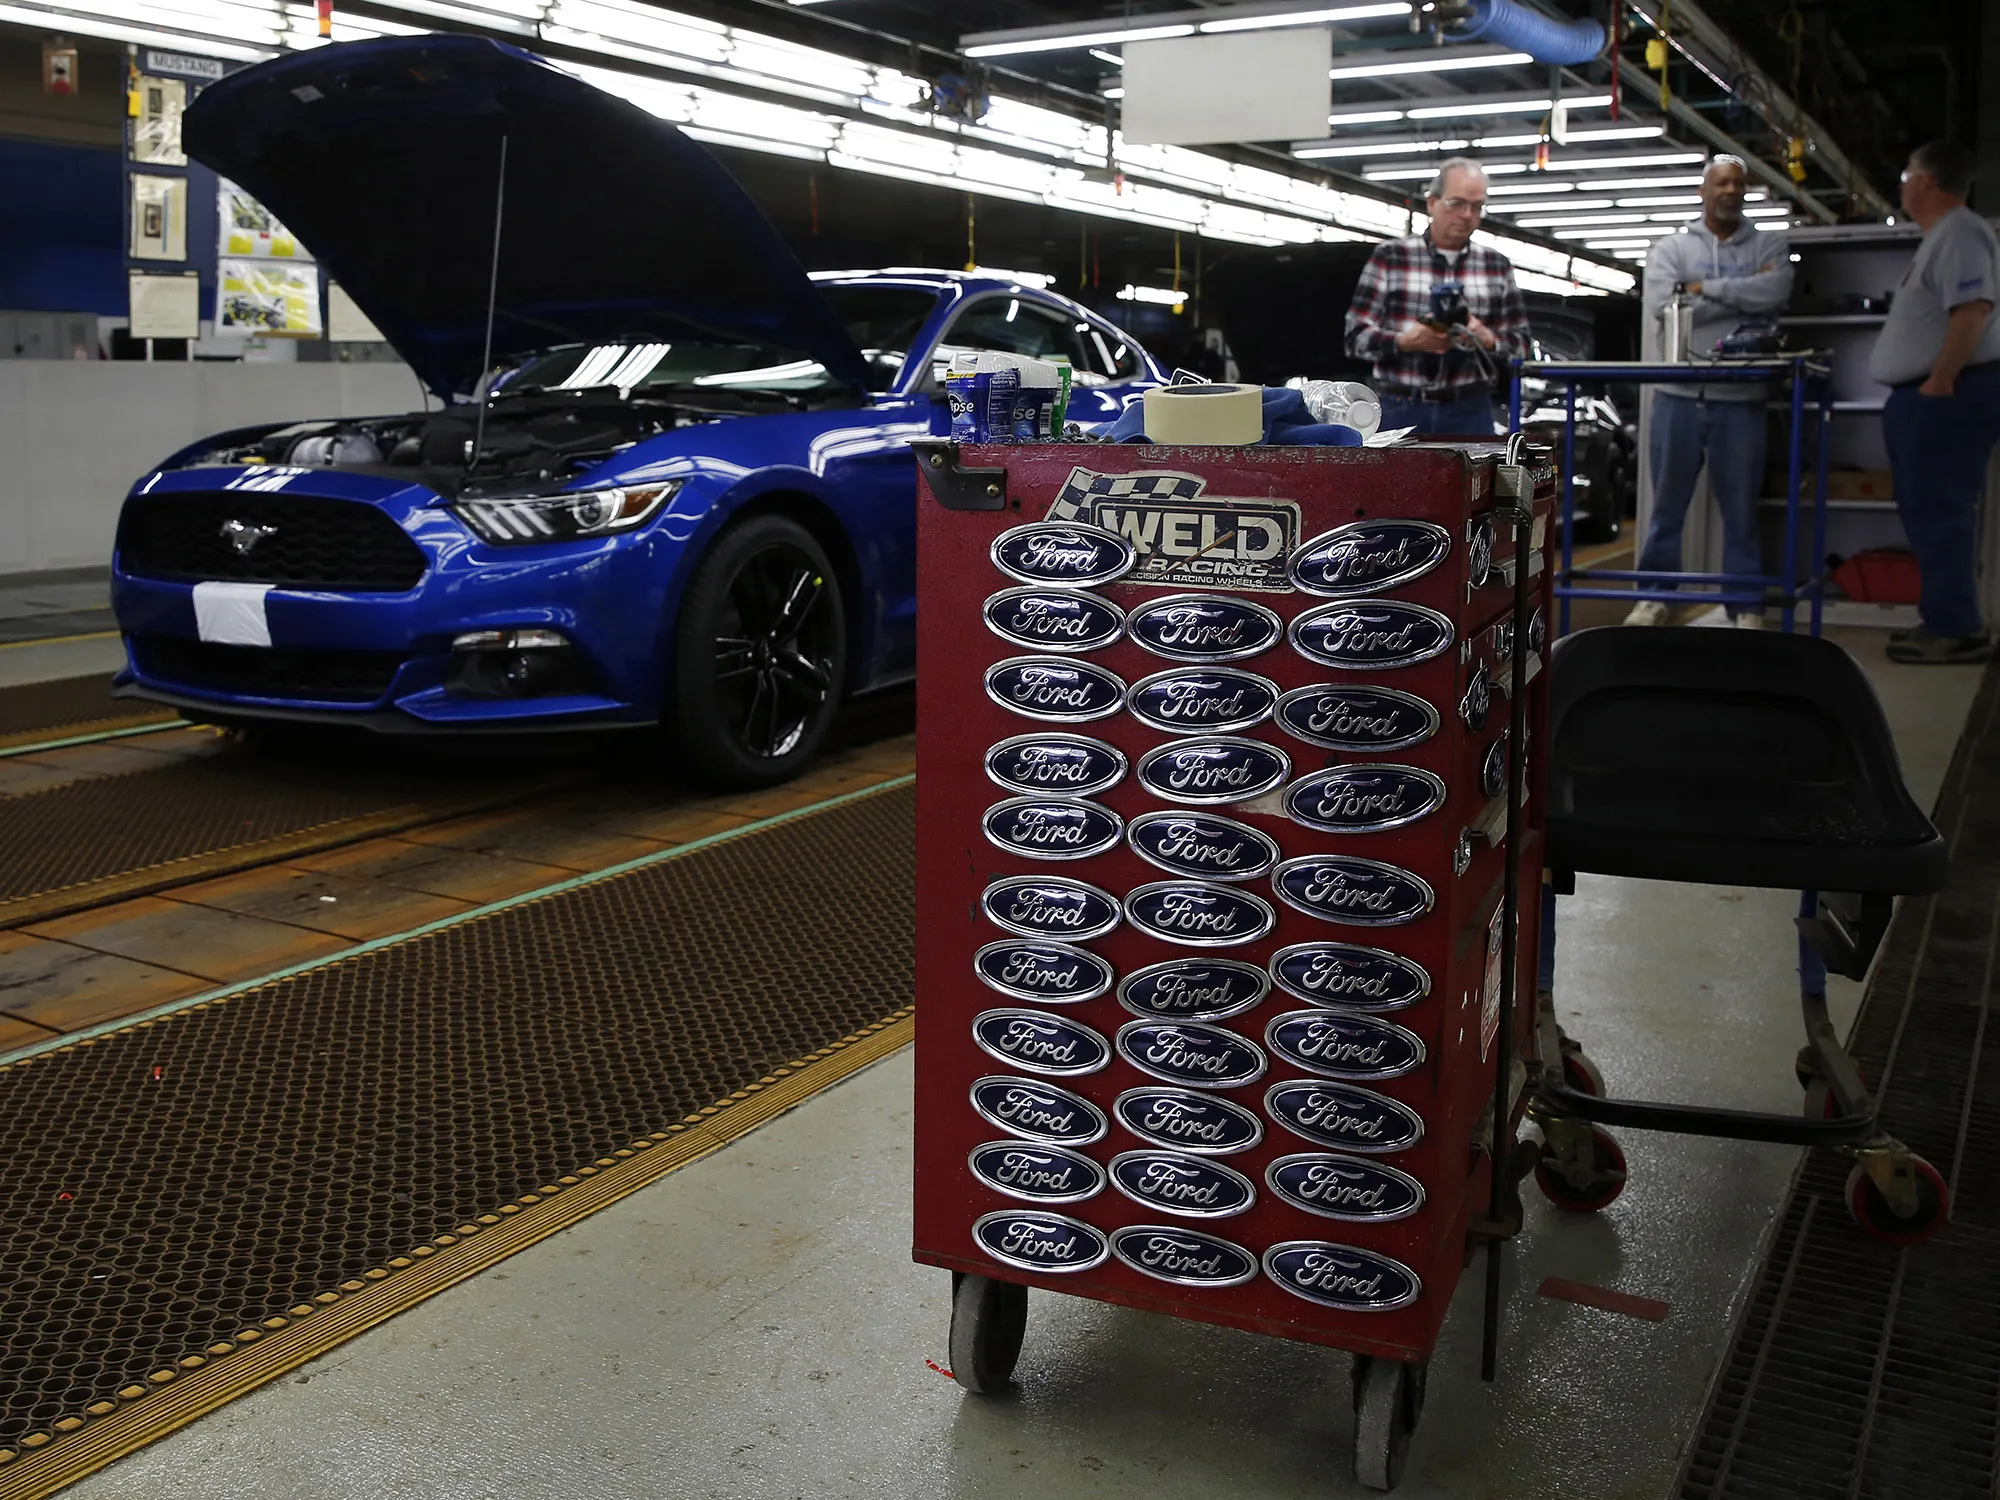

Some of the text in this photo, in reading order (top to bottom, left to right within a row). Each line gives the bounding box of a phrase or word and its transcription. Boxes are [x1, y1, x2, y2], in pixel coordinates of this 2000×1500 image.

[1020, 535, 1098, 573] Ford
[1101, 509, 1284, 561] WELD
[1146, 558, 1269, 577] RACING
[1326, 534, 1410, 582] Ford
[1128, 571, 1263, 587] ECISION RACING WHEELS
[1012, 599, 1092, 636] Ford
[1159, 606, 1243, 646] Ford
[1328, 611, 1415, 652] Ford
[1012, 669, 1092, 707] Ford
[1160, 680, 1243, 717] Ford
[1308, 696, 1400, 736] Ford
[1012, 747, 1092, 782] Ford
[1169, 750, 1253, 788] Ford
[1318, 778, 1405, 817] Ford
[1011, 808, 1088, 844] Ford
[1156, 823, 1240, 866] Ford
[1009, 889, 1086, 926] Ford
[1304, 868, 1395, 910] Ford
[1154, 893, 1239, 932] Ford
[1002, 952, 1078, 989] Ford
[1301, 955, 1391, 997] Ford
[1150, 974, 1234, 1009] Ford
[1000, 1022, 1076, 1062] Ford
[1146, 1031, 1229, 1073] Ford
[1298, 1024, 1384, 1065] Ford
[996, 1089, 1072, 1133] Ford
[1143, 1098, 1226, 1142] Ford
[1296, 1094, 1387, 1139] Ford
[996, 1151, 1072, 1190] Ford
[1138, 1163, 1219, 1205] Ford
[1297, 1165, 1384, 1208] Ford
[1000, 1221, 1076, 1259] Ford
[1140, 1236, 1221, 1275] Ford
[1294, 1253, 1380, 1297] Ford
